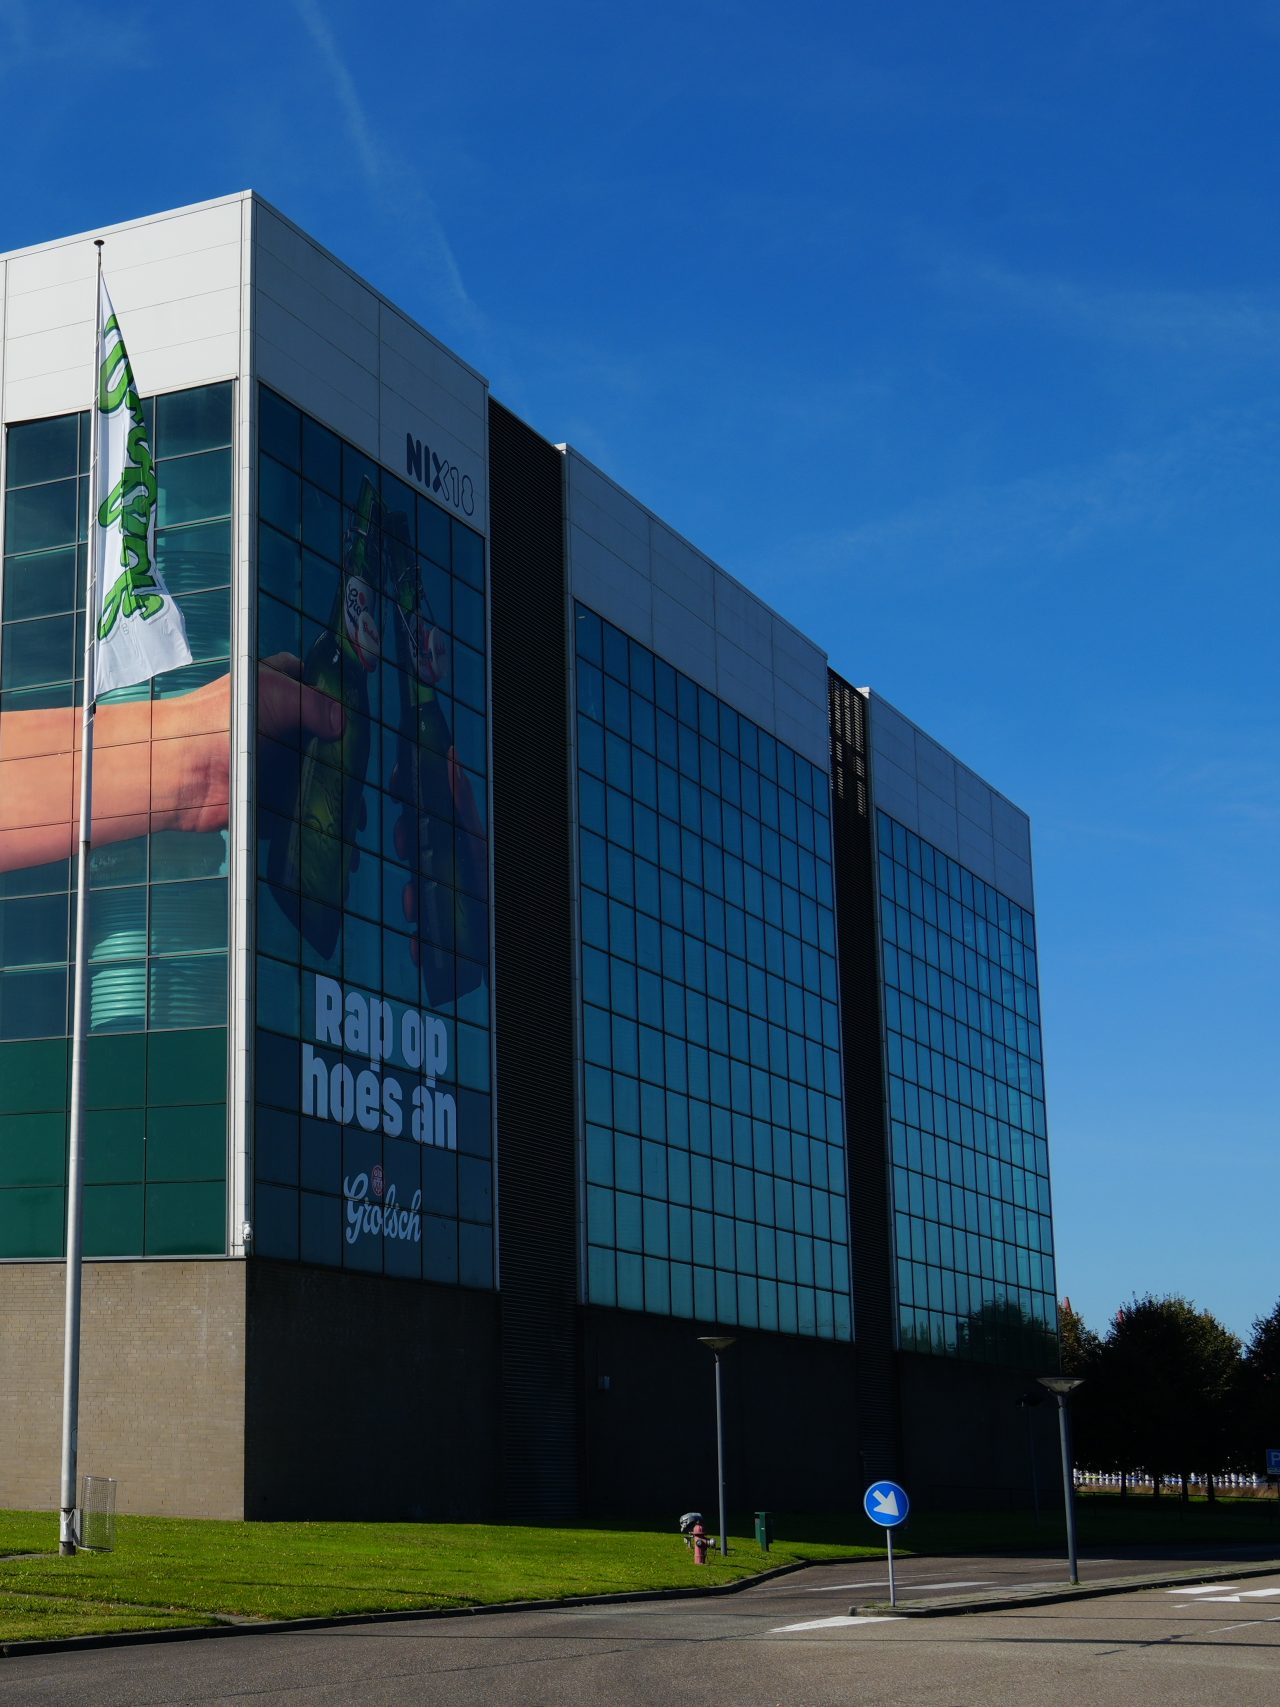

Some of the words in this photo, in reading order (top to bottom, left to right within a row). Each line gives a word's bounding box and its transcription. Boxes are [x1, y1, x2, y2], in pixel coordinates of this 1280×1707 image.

[406, 432, 474, 516] NIX18
[315, 973, 393, 1072] Rap
[401, 1009, 448, 1087] op
[302, 1043, 403, 1138] hoes
[411, 1085, 457, 1150] an
[343, 1172, 422, 1244] Grolsch
